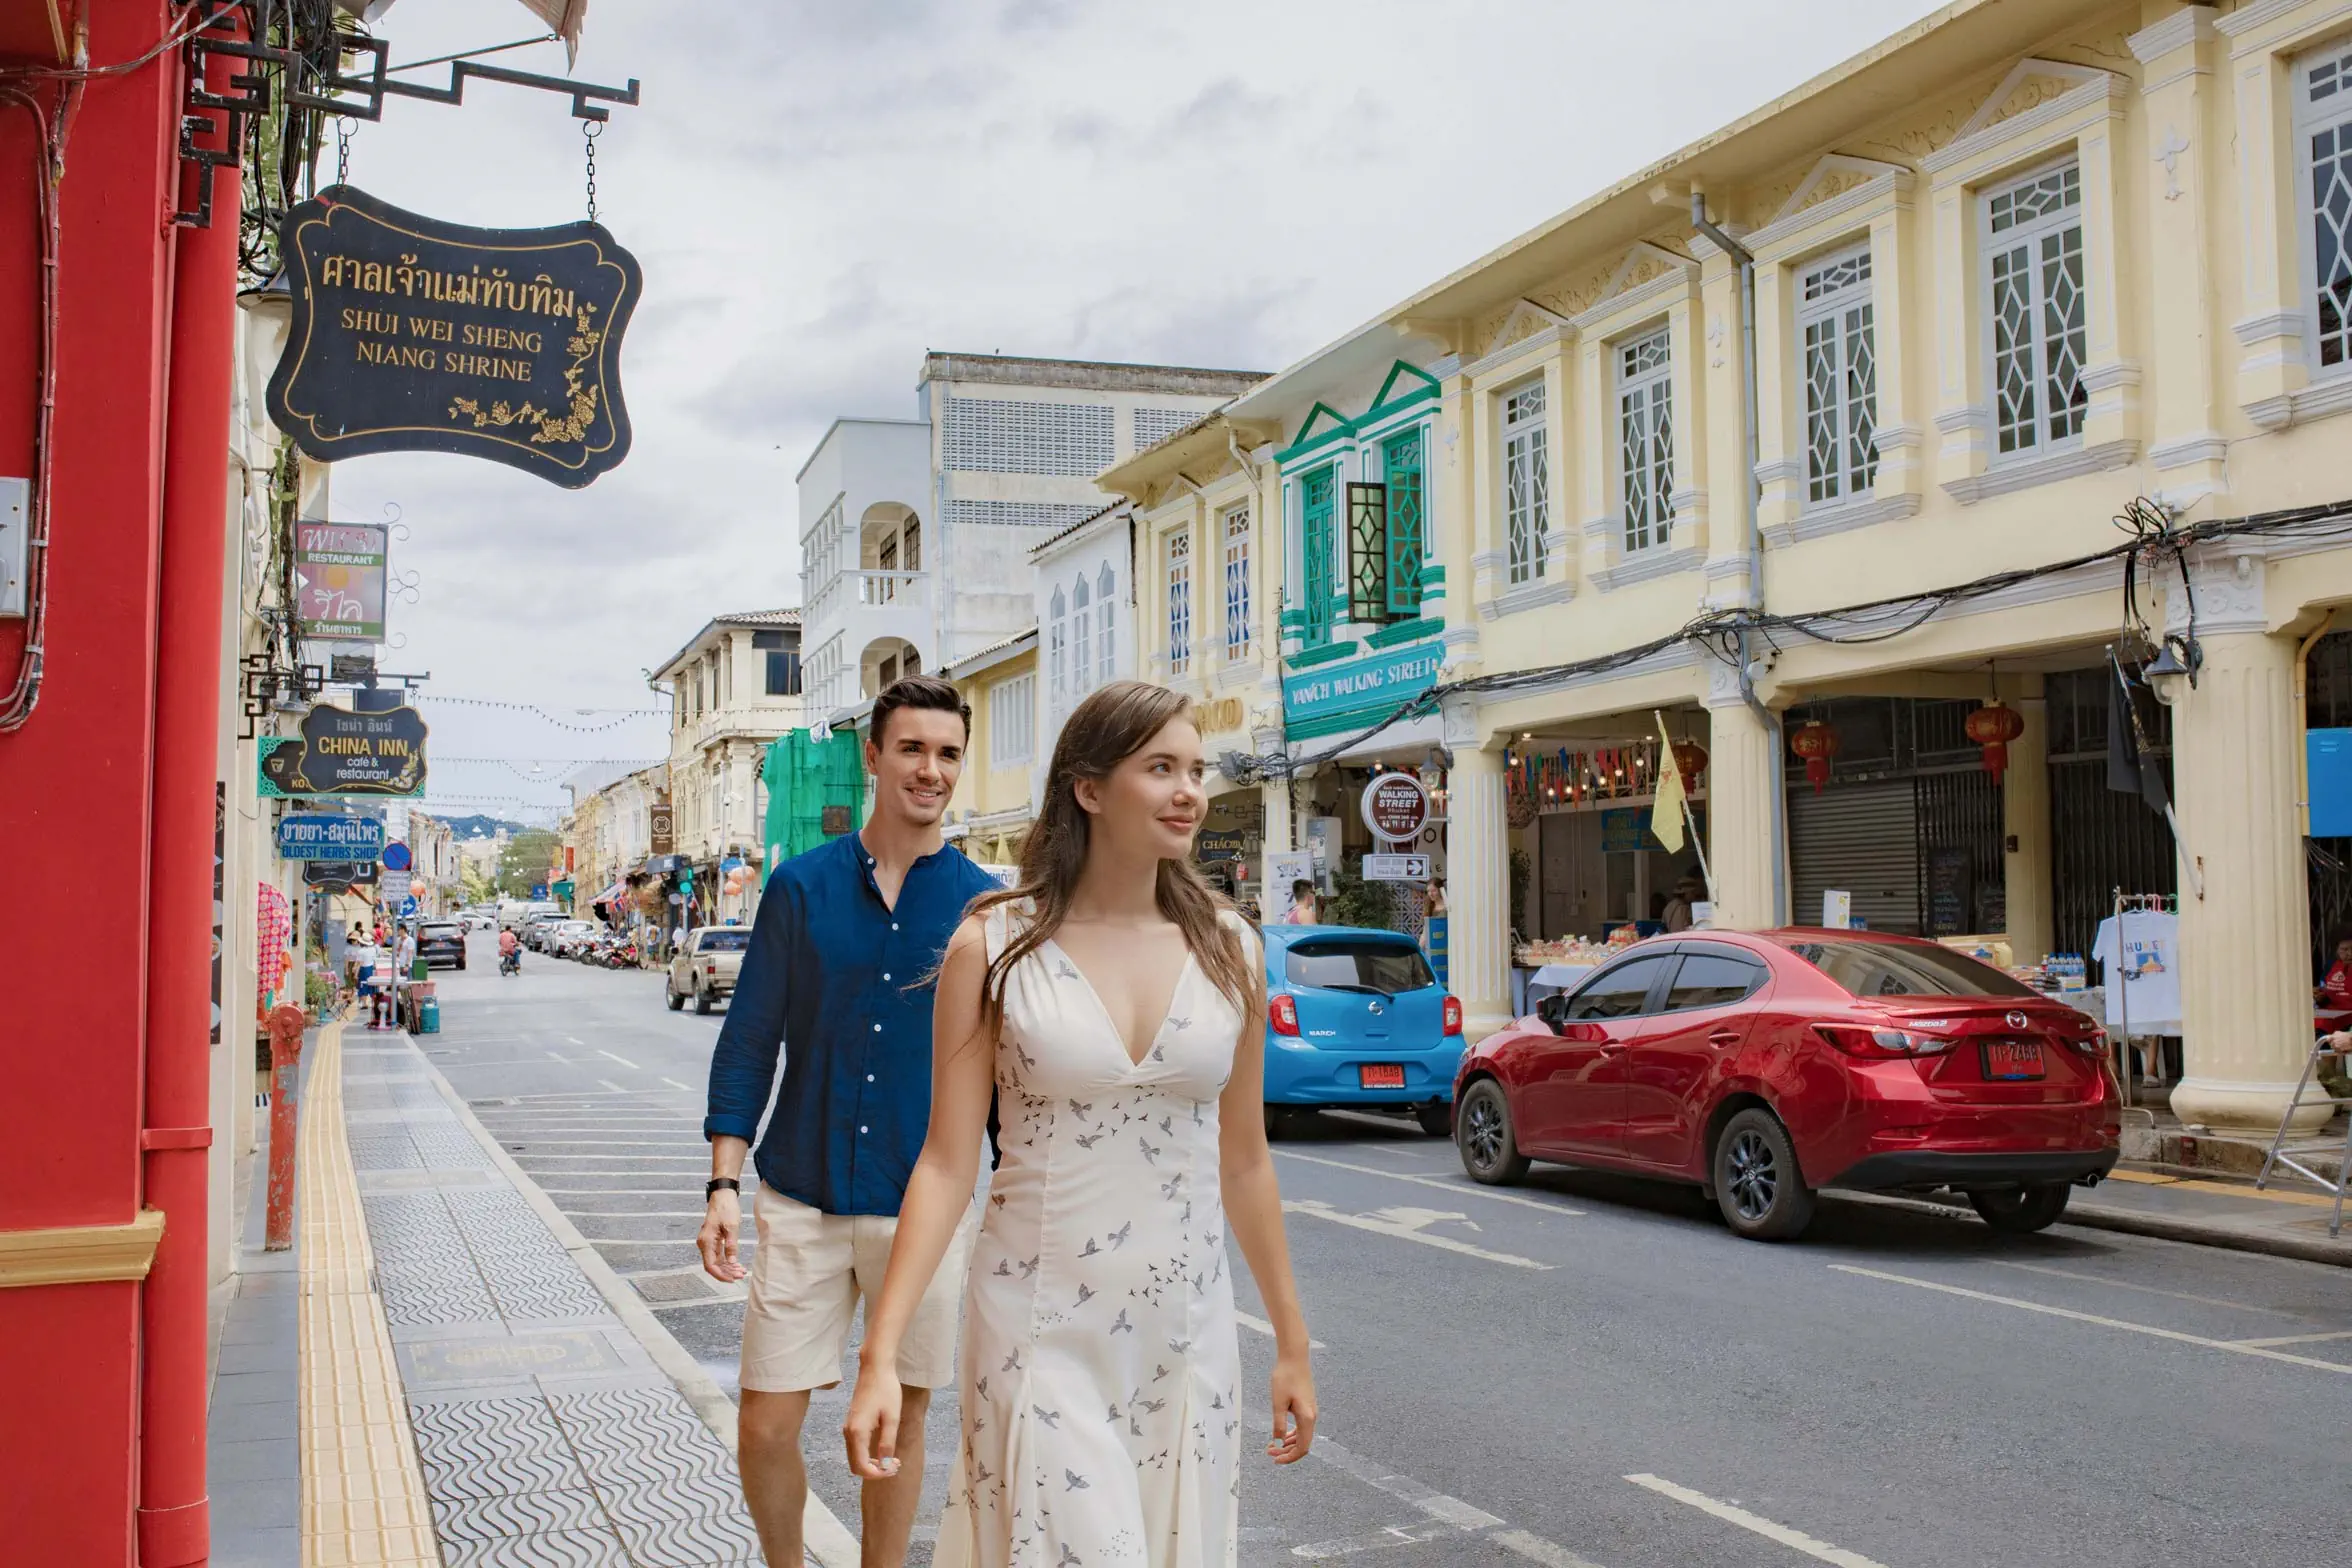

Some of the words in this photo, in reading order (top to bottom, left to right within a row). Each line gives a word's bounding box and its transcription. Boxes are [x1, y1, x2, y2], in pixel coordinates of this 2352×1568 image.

[322, 253, 574, 318] ศาลเจ้าแม่ทับทิม
[341, 308, 398, 335] SHUI
[408, 316, 453, 342] WEI
[462, 324, 543, 353] SHENG
[356, 340, 436, 371] NIANG
[444, 352, 533, 382] SHRINE
[308, 553, 375, 565] RESTAURANT
[1388, 657, 1431, 684] STREET
[318, 737, 371, 755] CHINA
[378, 738, 408, 757] INN
[347, 756, 370, 767] café
[371, 757, 379, 767] &
[336, 767, 390, 780] restaurant
[1378, 790, 1419, 799] WALKING
[1378, 799, 1419, 808] STREET
[282, 845, 318, 858] OLDEST
[320, 846, 351, 859] HERBS
[354, 846, 379, 859] SHOP
